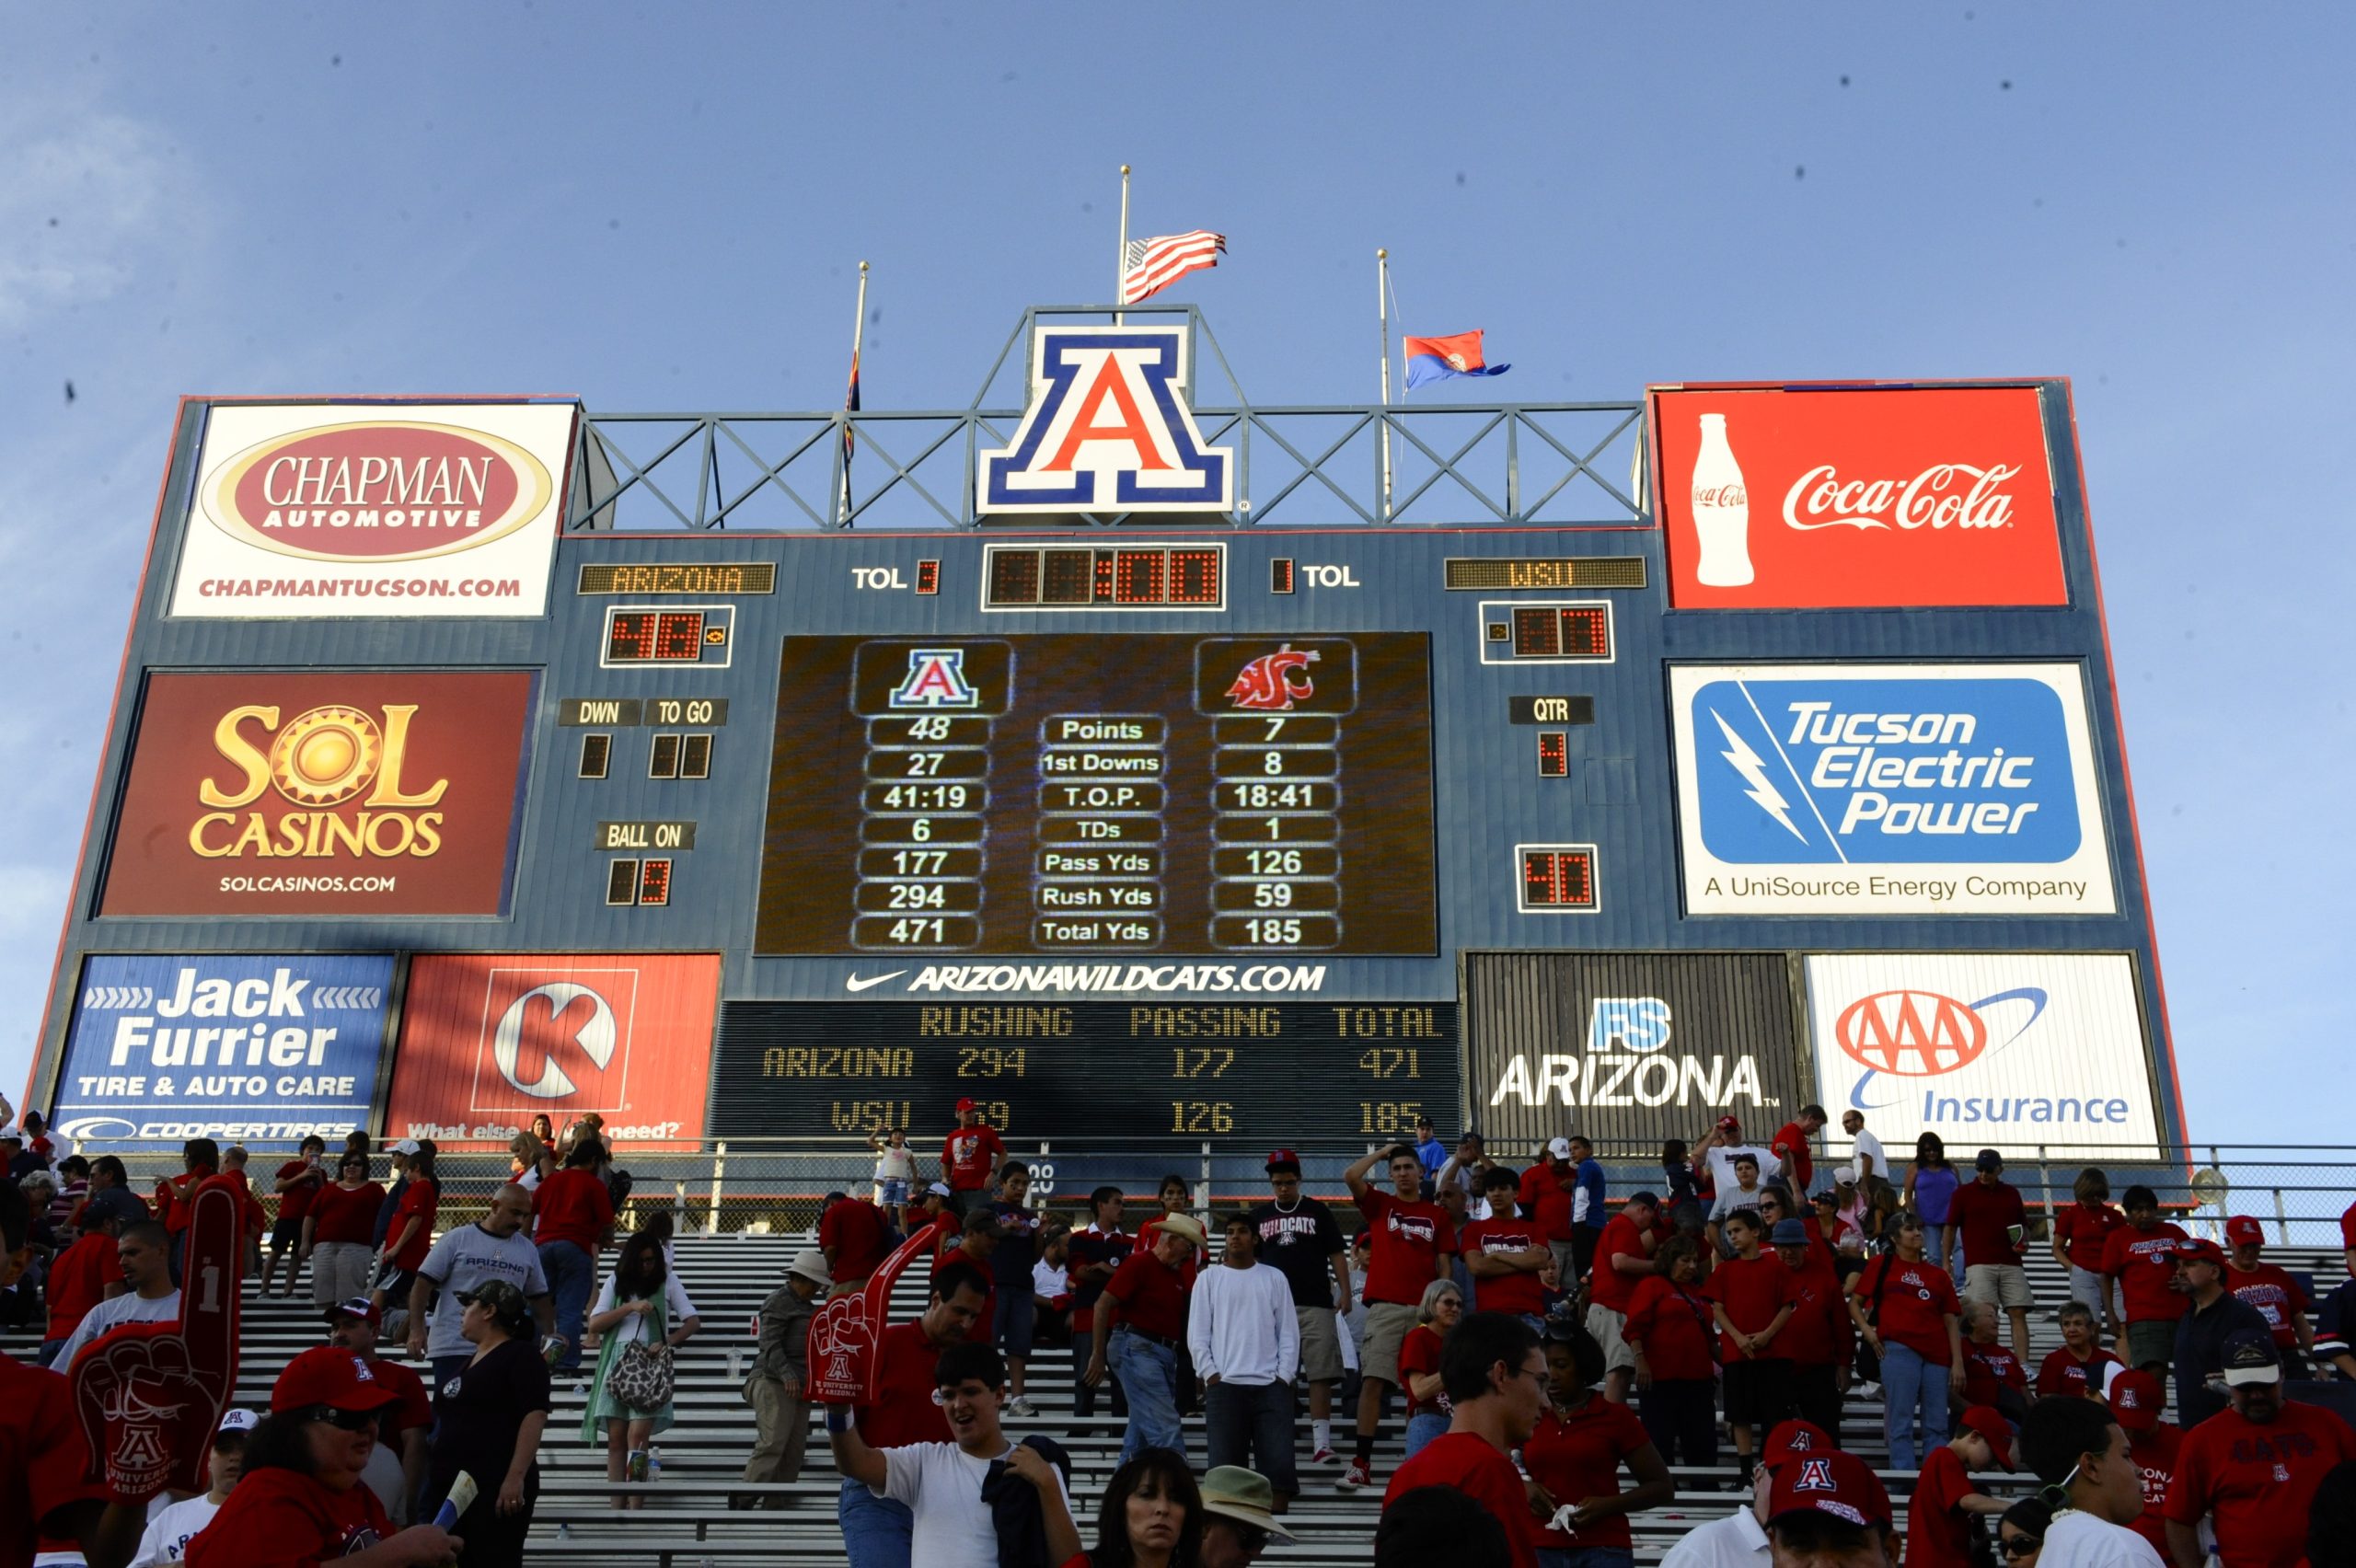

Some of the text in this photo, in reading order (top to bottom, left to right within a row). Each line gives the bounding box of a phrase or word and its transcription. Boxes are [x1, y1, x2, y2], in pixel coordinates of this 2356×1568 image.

[261, 455, 495, 507] CHAPMAN
[1782, 463, 2023, 530] Coca-Cola
[261, 509, 481, 528] AUTOMOTIVE
[612, 567, 744, 593] ARIZONA
[852, 568, 907, 589] TOL
[920, 563, 938, 594] 3
[1302, 565, 1360, 587] TOL
[1510, 562, 1575, 587] WSU
[198, 579, 522, 598] CHAPMANTUCSON.COM
[612, 615, 701, 659] 48
[579, 701, 620, 724] DWN
[659, 701, 712, 723] TO GO
[1533, 699, 1568, 721] QTR
[908, 717, 951, 740] 48
[1062, 721, 1143, 739] Points
[1265, 718, 1285, 741] 7
[1788, 701, 1977, 744] Tucson
[199, 703, 448, 809] SOL
[907, 754, 945, 776] 27
[1043, 755, 1160, 770] 1st Downs
[1265, 752, 1282, 775] 8
[1541, 735, 1564, 773] 4
[1810, 746, 2035, 788] Electric
[884, 786, 966, 808] 41:19
[1064, 788, 1140, 806] T.O.P.
[1234, 785, 1313, 807] 18:41
[1838, 791, 2039, 835] Power
[189, 812, 444, 859] CASINOS
[607, 824, 681, 847] BALL ON
[912, 819, 930, 841] 6
[1077, 821, 1121, 838] TDs
[1265, 818, 1279, 841] 1
[893, 851, 948, 874] 177
[1045, 855, 1149, 871] Pass Yds
[1246, 850, 1302, 874] 126
[219, 875, 397, 893] SOLCASINOS.COM
[645, 862, 668, 903] 9
[1526, 855, 1589, 903] 40
[1705, 876, 2087, 901] A UniSource Energy Company
[889, 885, 945, 908] 294
[1043, 888, 1152, 905] Rush Yds
[1254, 883, 1292, 907] 59
[889, 919, 944, 942] 471
[1043, 922, 1149, 940] Total Yds
[1245, 919, 1301, 943] 185
[907, 965, 1326, 992] ARIZONAWILDCATS.COM
[156, 968, 310, 1017] Jack
[920, 1007, 1073, 1036] RUSHING
[1130, 1008, 1280, 1037] PASSING
[1333, 1008, 1443, 1037] TOTAL
[1588, 997, 1671, 1053] FS
[1848, 990, 1981, 1076] AAA
[110, 1016, 338, 1066] Furrier
[762, 1047, 1421, 1078] ARIZONA 294 177 471
[77, 1076, 355, 1096] TIRE & AUTO CARE
[1490, 1055, 1763, 1106] ARIZONA
[832, 1101, 910, 1131] WSU
[1172, 1102, 1233, 1132] 126
[1360, 1102, 1421, 1133] 185
[1923, 1090, 2130, 1124] Insurance
[408, 1123, 520, 1140] What else
[608, 1122, 680, 1140] need?
[1028, 1164, 1055, 1193] 28
[1259, 1216, 1316, 1242] WILDCATS
[467, 1257, 525, 1275] ARIZONA
[2232, 1433, 2314, 1463] CATS
